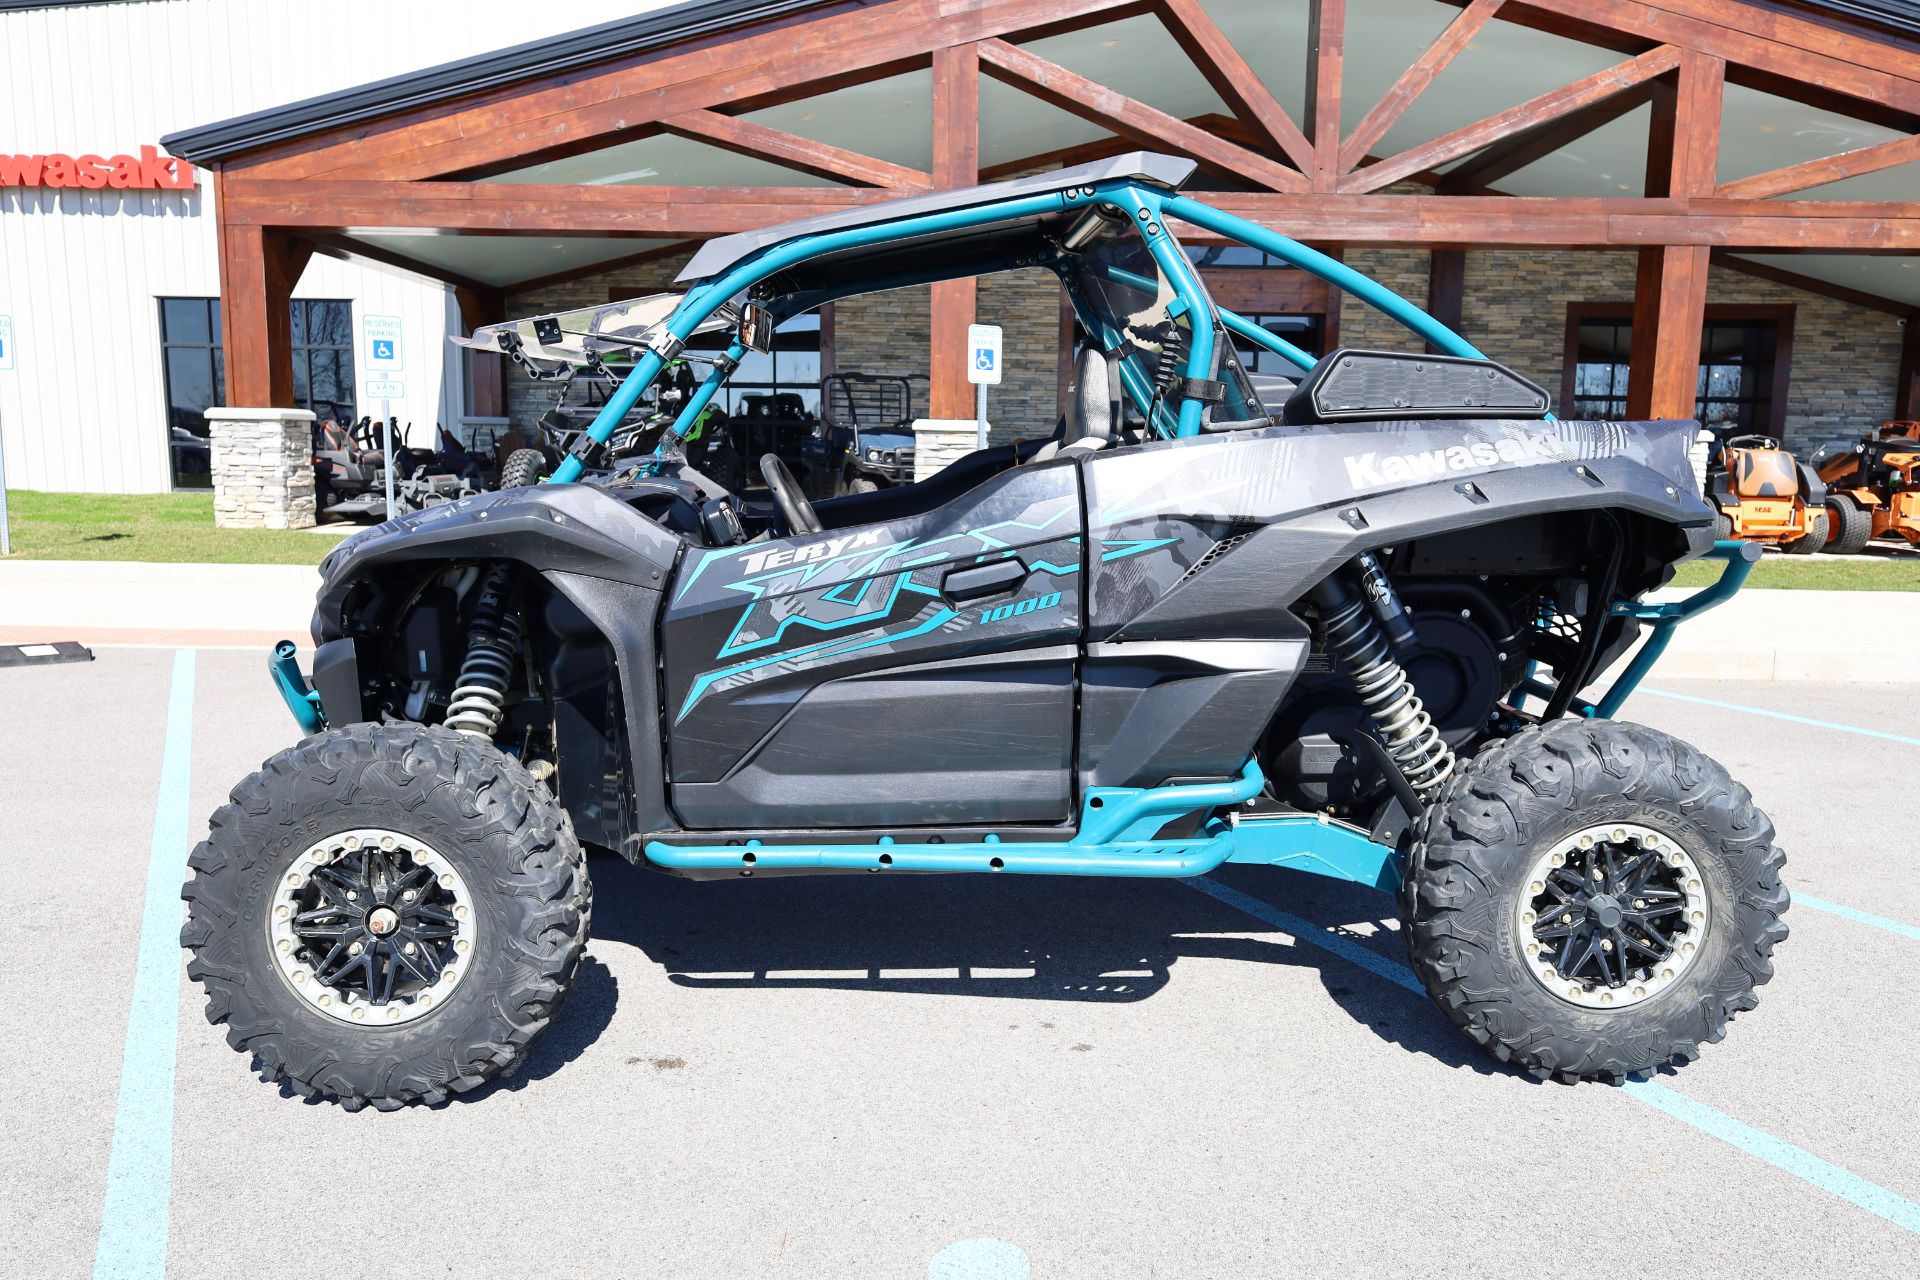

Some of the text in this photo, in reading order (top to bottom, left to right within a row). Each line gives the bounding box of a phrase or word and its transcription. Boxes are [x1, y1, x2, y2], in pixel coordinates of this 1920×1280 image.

[0, 144, 195, 189] wasaki
[1343, 430, 1565, 491] Kawasaki
[979, 591, 1062, 625] 1000
